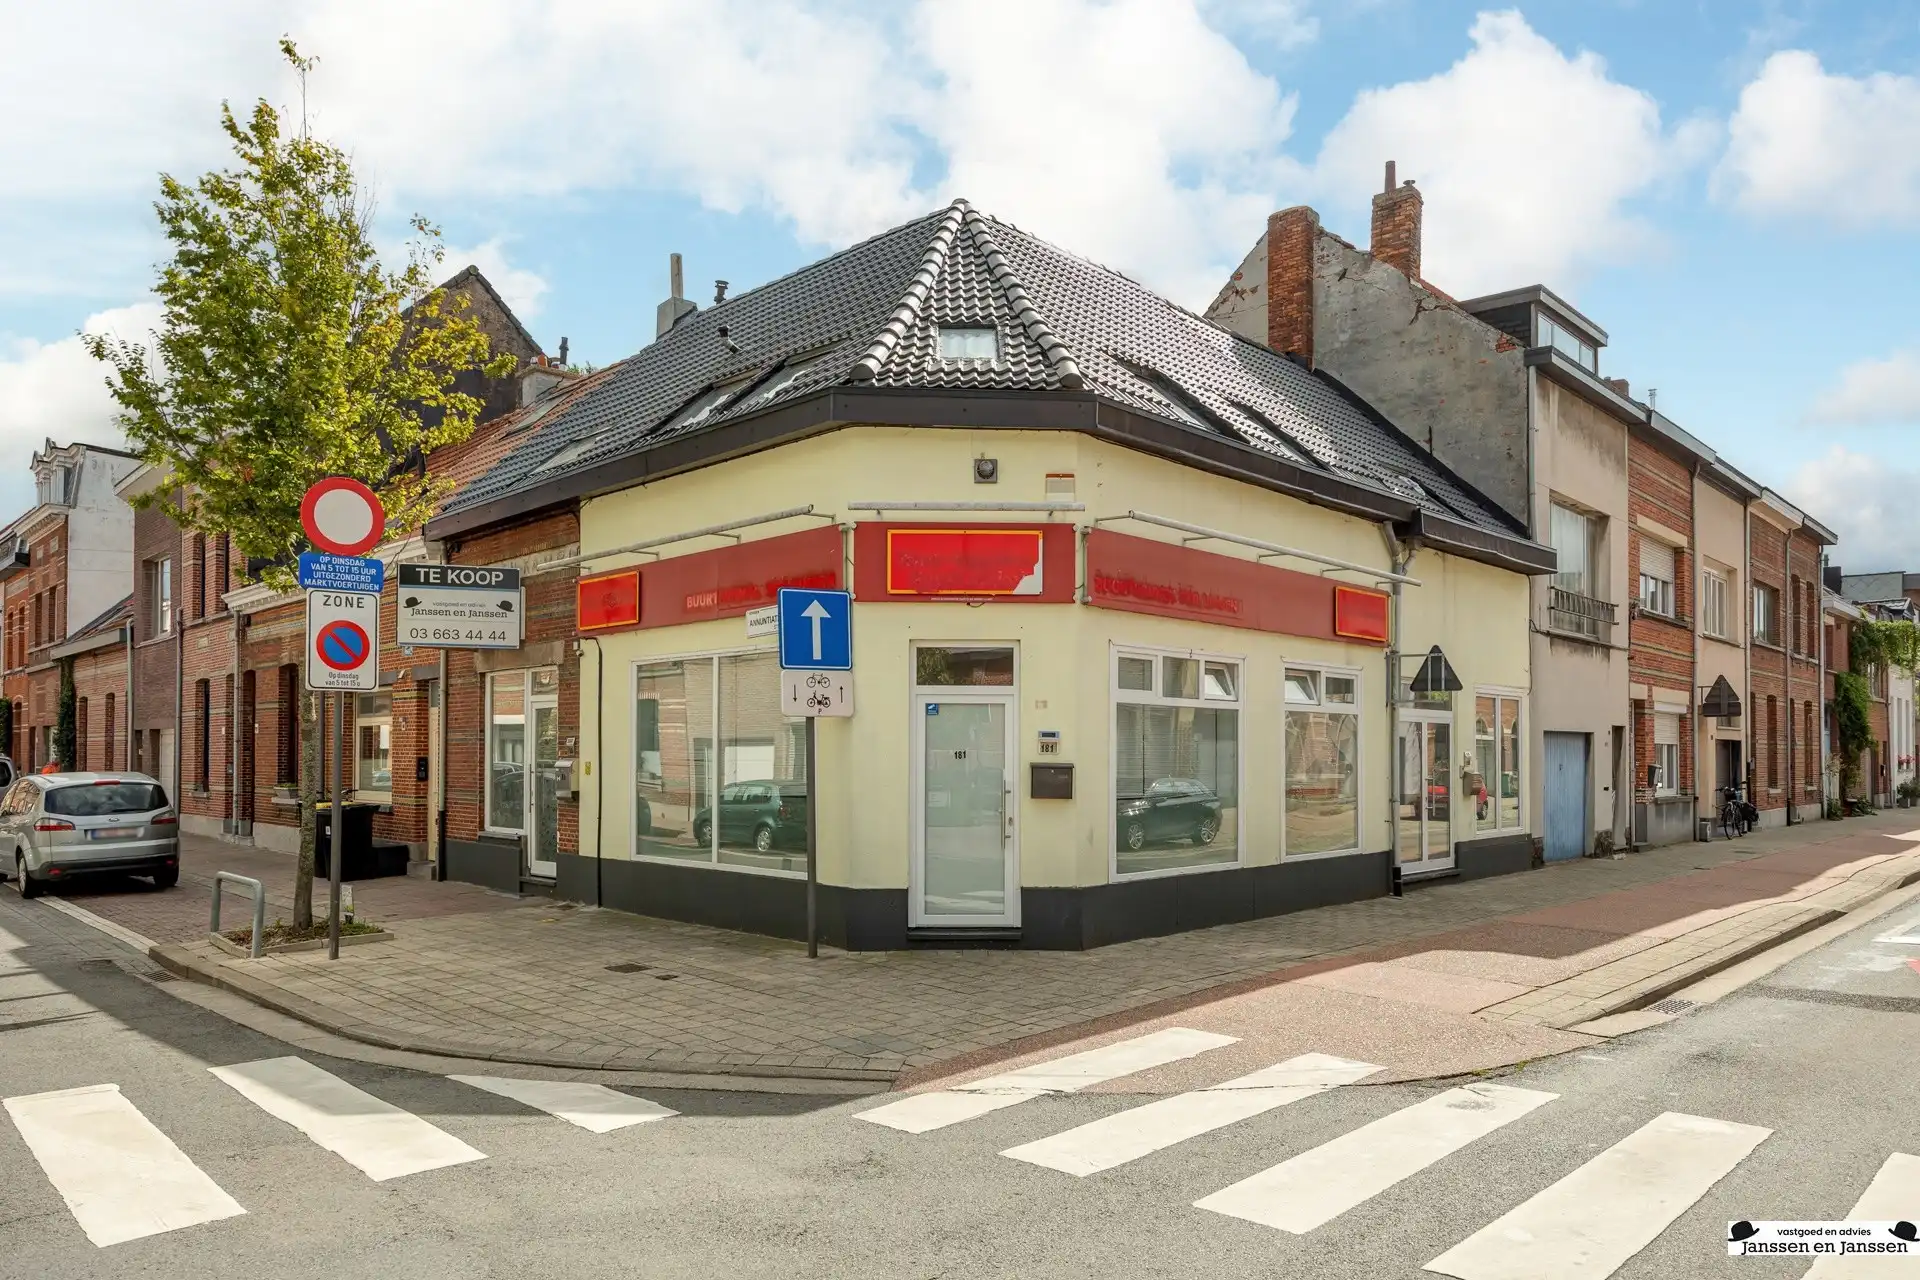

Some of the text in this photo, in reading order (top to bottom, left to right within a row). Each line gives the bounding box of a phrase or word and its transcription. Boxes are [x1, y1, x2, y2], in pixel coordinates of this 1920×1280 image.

[332, 557, 365, 567] DINSDAG
[311, 563, 326, 571] VAN
[328, 564, 333, 572] 5
[361, 568, 377, 576] UUR
[313, 571, 371, 583] UITGEZONDERD
[415, 567, 504, 586] TE KOOP
[304, 578, 380, 591] MARKTVOERTUIGEN
[323, 595, 365, 609] ZONE
[411, 607, 508, 618] Janssen en Janssen
[749, 615, 779, 627] ANNUNTIAT
[410, 627, 507, 642] 03 663 44 44
[328, 671, 359, 680] Op dinsdag
[1040, 744, 1054, 753] 181
[954, 750, 967, 760] 181
